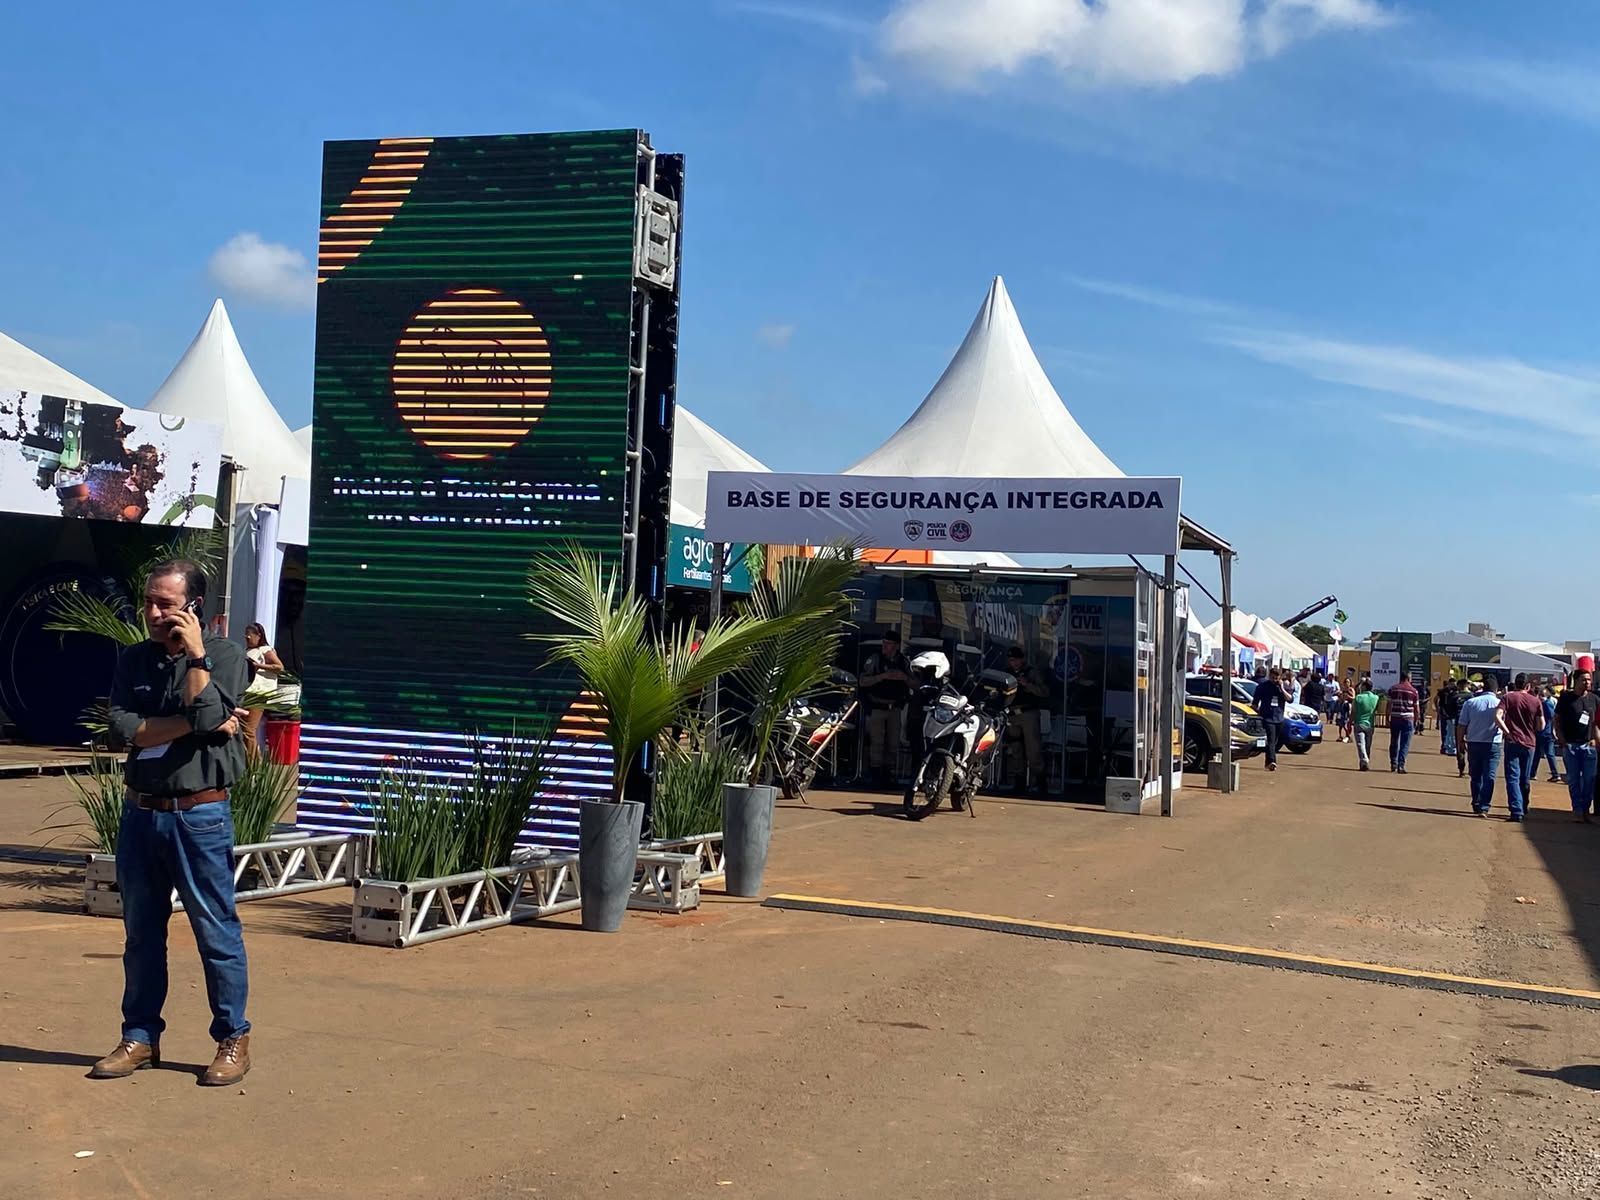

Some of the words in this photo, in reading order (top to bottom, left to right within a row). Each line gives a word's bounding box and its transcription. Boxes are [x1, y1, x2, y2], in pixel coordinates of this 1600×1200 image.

[727, 491, 790, 508] BASE
[801, 491, 830, 508] DE
[839, 491, 998, 513] SEGURANÇA
[1008, 491, 1164, 509] INTEGRADA
[926, 529, 947, 537] CIVIL
[946, 584, 1024, 600] SEGURANÇA
[1071, 615, 1103, 629] CIVIL
